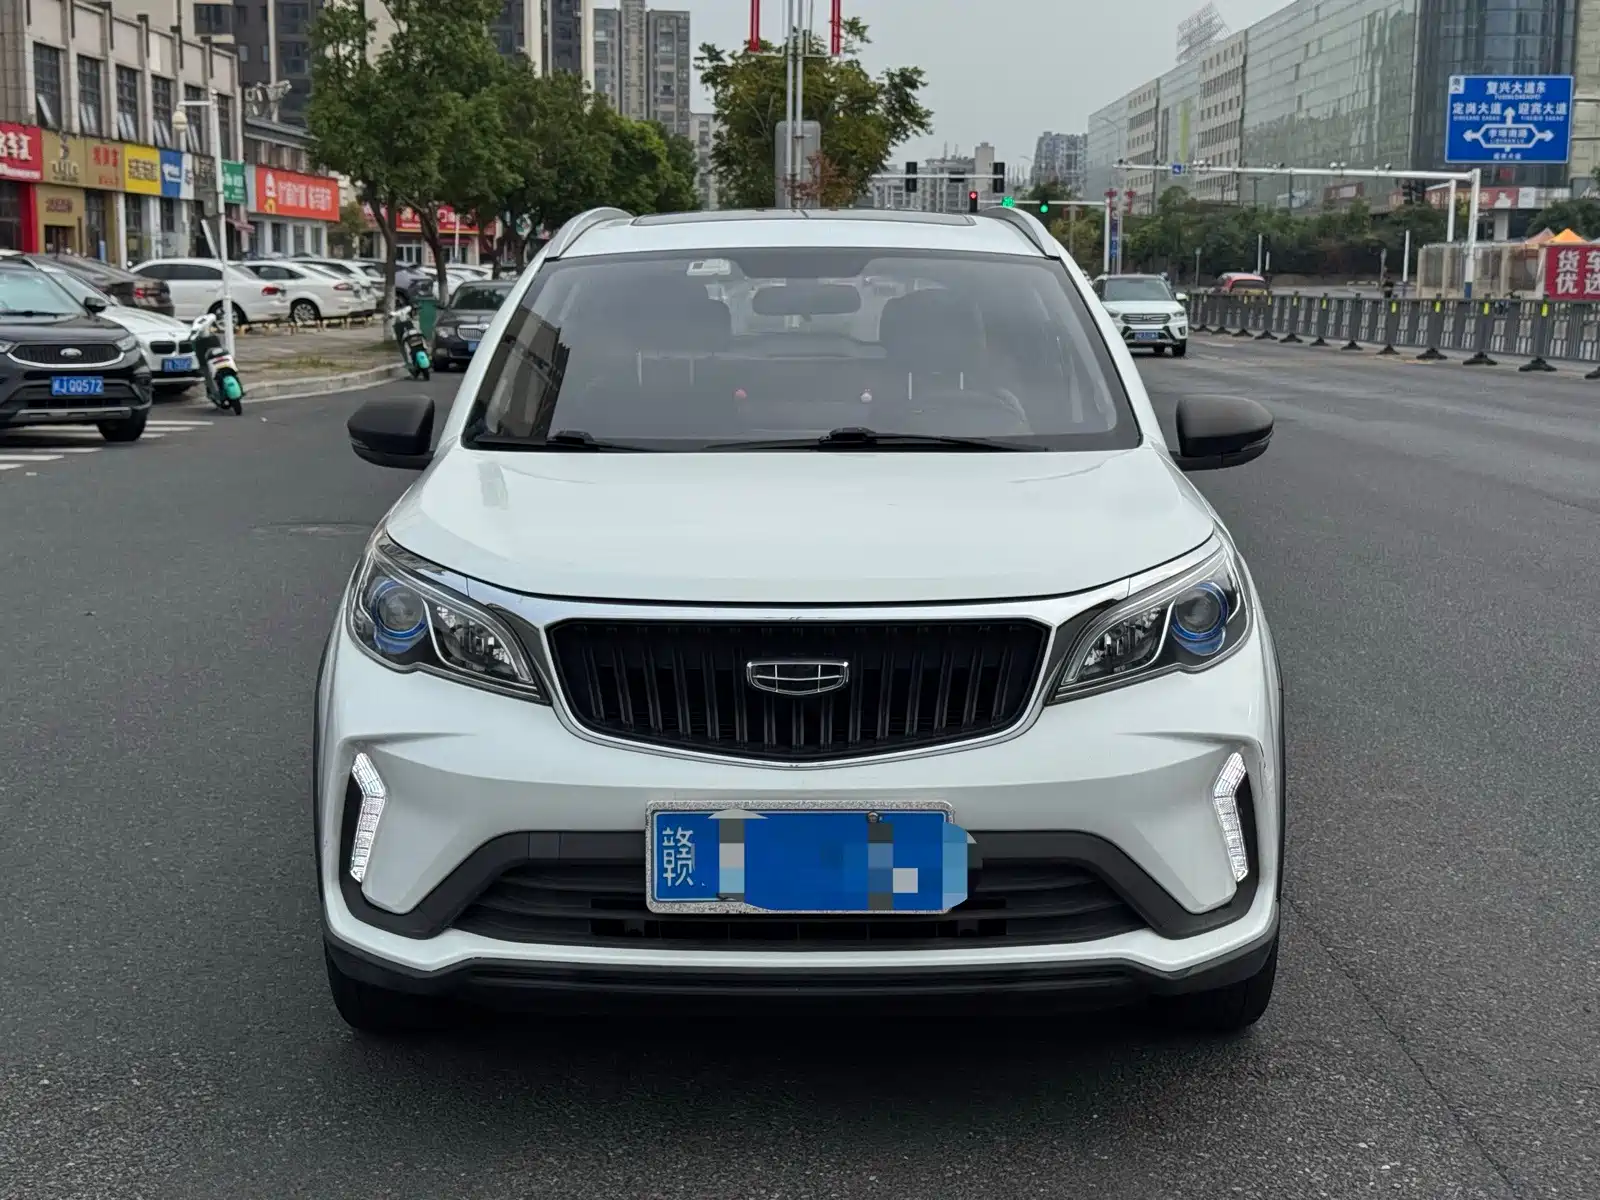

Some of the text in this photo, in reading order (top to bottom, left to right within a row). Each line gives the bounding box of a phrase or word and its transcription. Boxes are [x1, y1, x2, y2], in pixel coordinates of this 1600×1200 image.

[1518, 102, 1567, 115] 迎宾大道
[662, 826, 695, 887] 赣
